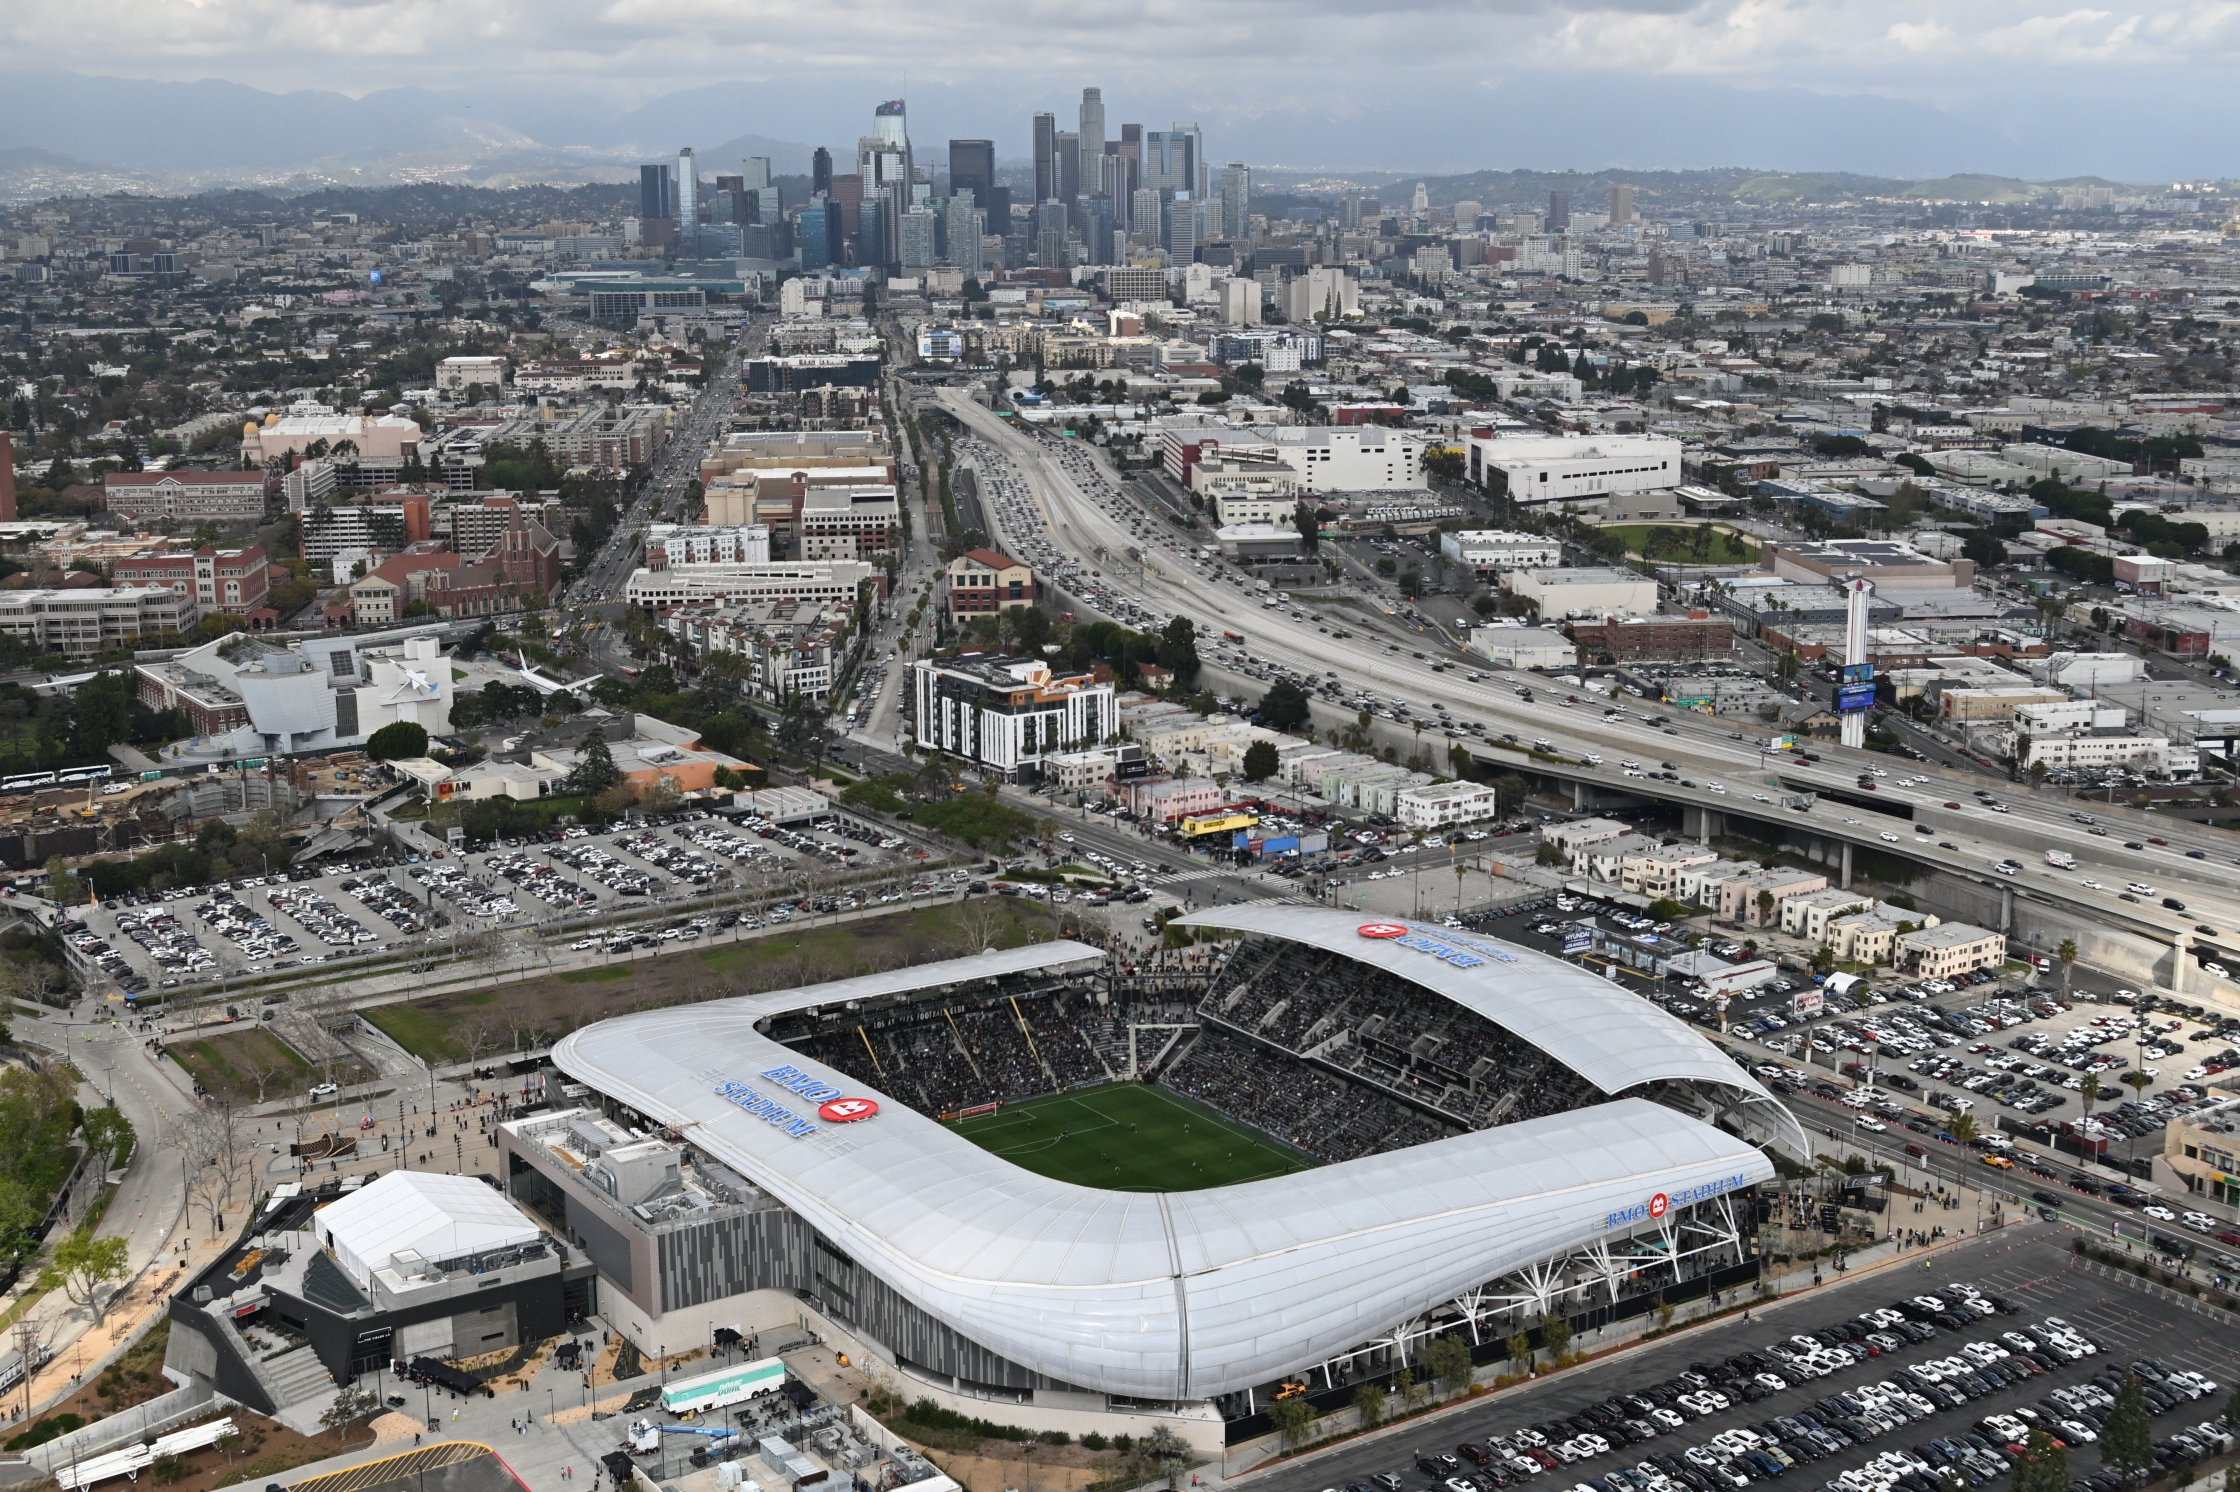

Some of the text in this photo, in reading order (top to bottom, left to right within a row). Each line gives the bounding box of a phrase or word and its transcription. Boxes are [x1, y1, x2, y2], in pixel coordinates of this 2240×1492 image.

[440, 781, 471, 794] CAAM
[1565, 931, 1590, 941] HYUNDAI
[1572, 939, 1590, 947] ANGELES
[1395, 935, 1485, 969] BMO
[873, 1020, 885, 1029] LOS
[760, 1064, 843, 1103] BMO
[713, 1079, 819, 1138] STADIUM
[1608, 1173, 1745, 1228] BMO STADIUM
